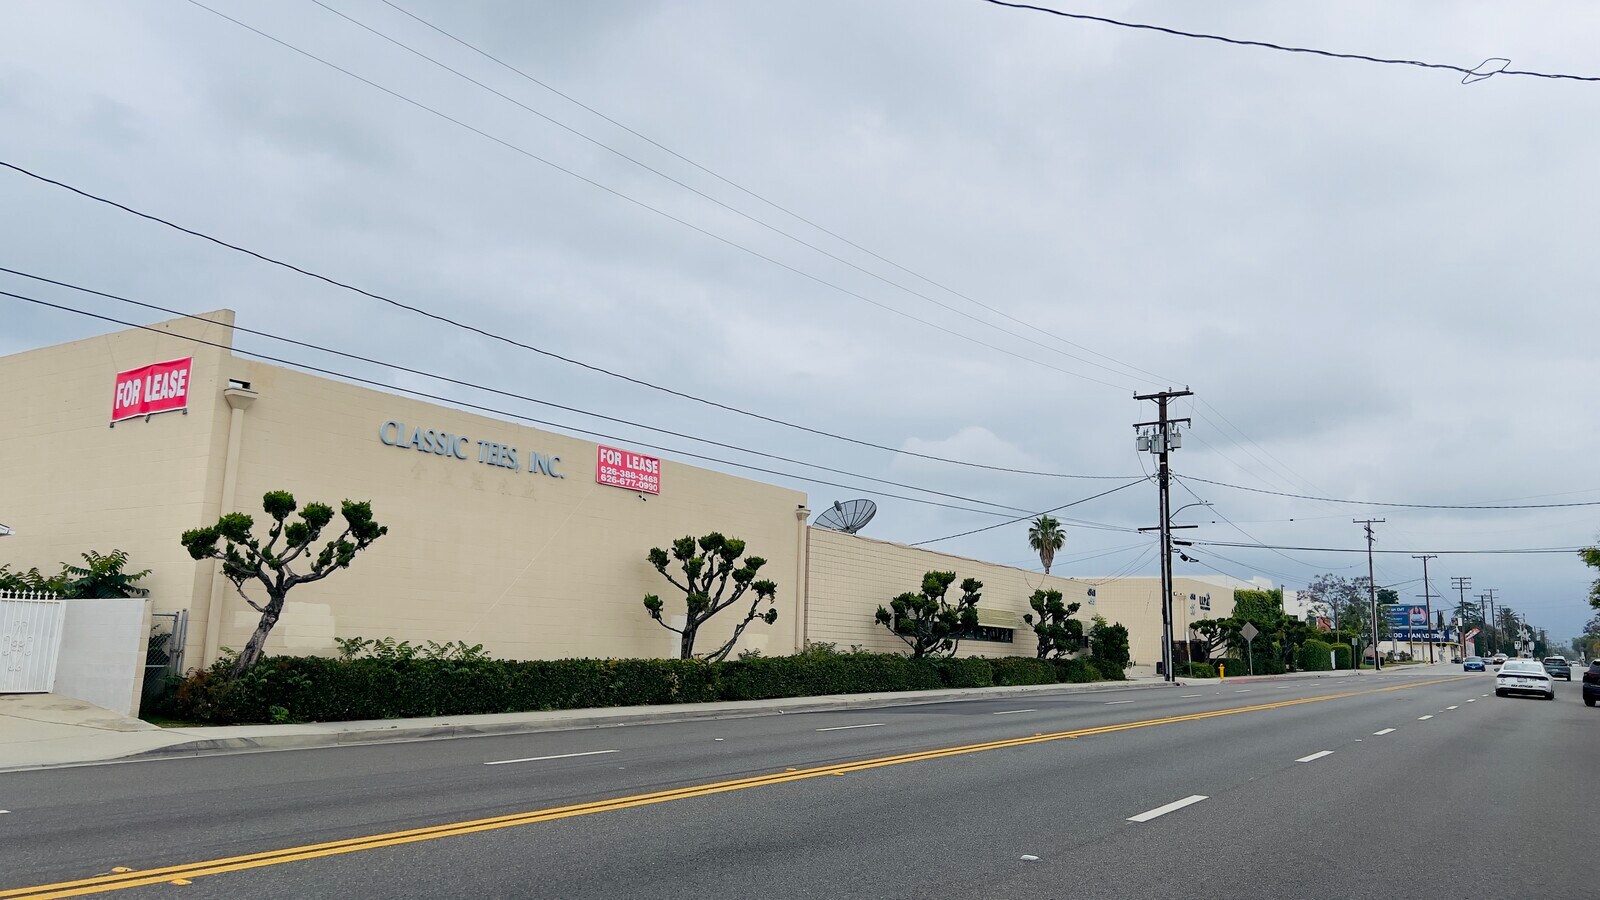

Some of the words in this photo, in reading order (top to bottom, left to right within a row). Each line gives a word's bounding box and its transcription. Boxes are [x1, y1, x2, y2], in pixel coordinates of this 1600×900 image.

[115, 378, 141, 409] FOR
[144, 369, 187, 402] LEASE
[379, 420, 469, 460] CLASSIC
[477, 440, 521, 473] TEES,
[528, 450, 565, 479] INC.
[600, 448, 622, 466] FOR
[626, 454, 659, 474] LEASE
[600, 466, 658, 483] 626-388-3468
[600, 474, 658, 491] 626-677-0990
